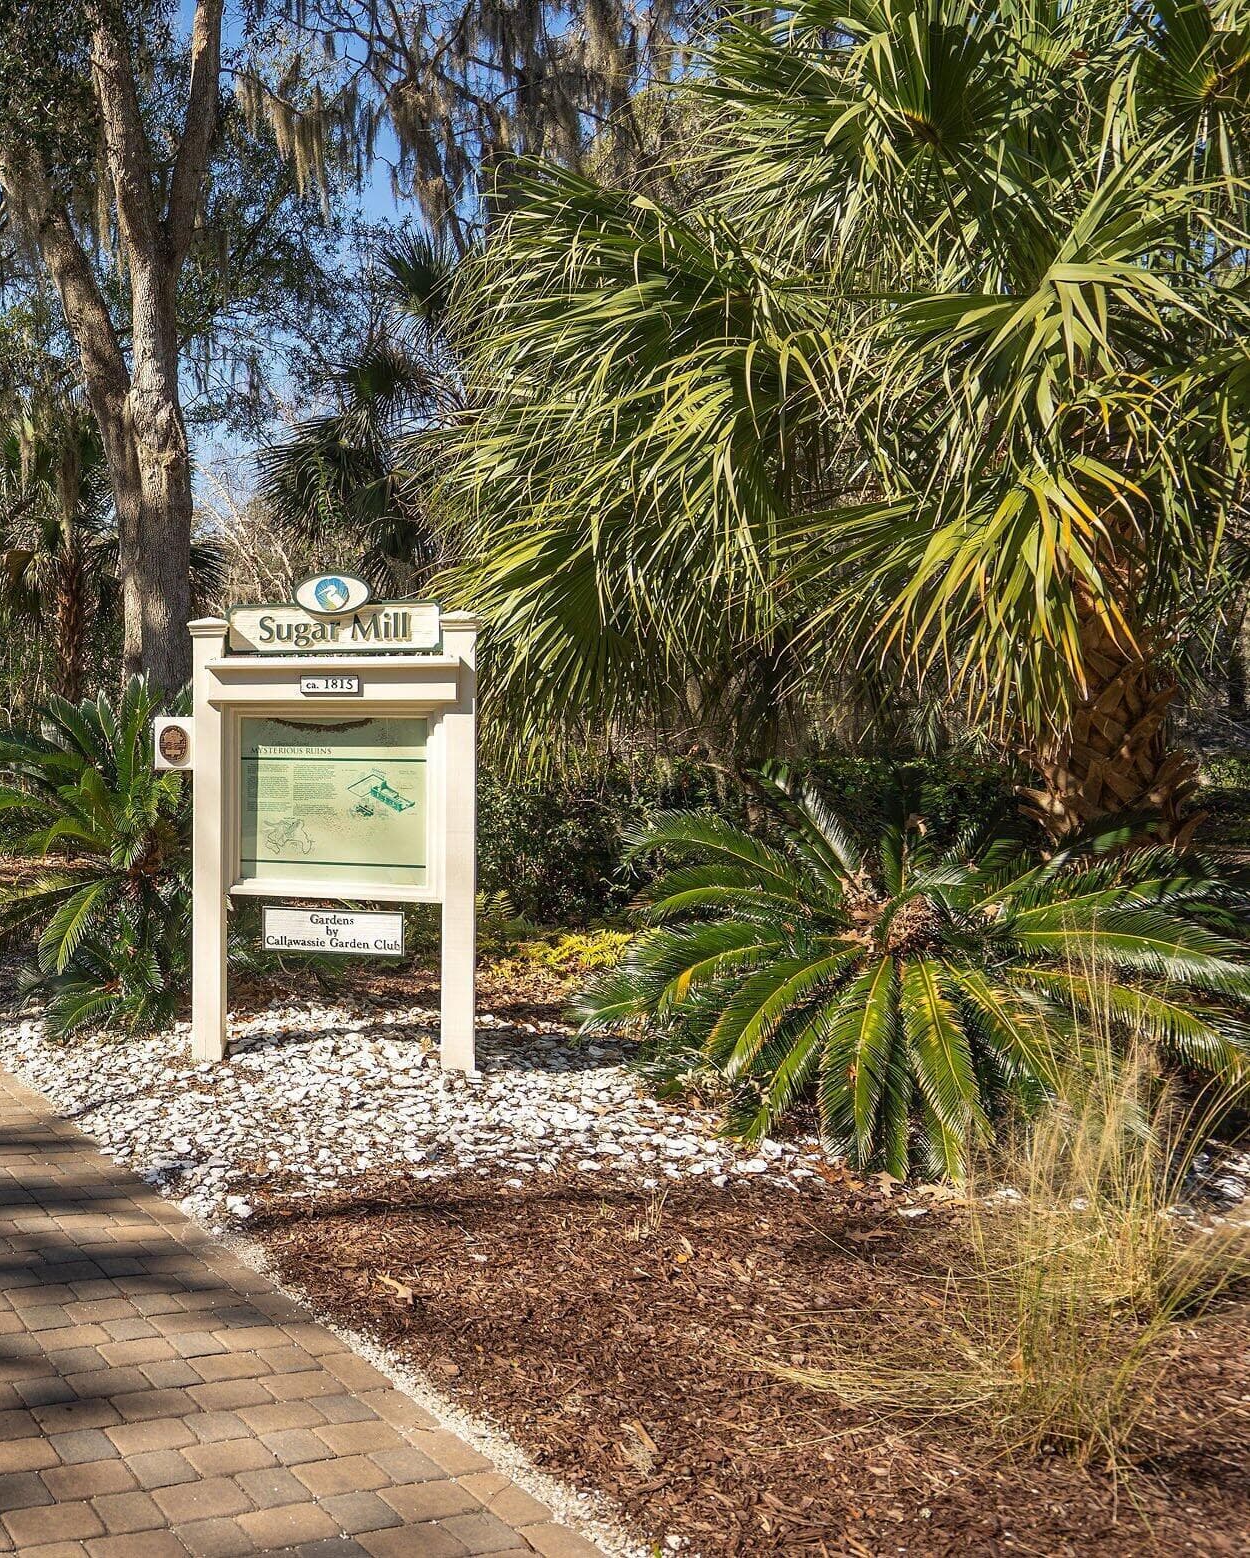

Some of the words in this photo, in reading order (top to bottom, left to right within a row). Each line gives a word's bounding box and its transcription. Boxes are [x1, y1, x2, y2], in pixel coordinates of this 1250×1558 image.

[258, 615, 341, 647] Sugar
[351, 611, 409, 640] Mill
[305, 681, 320, 690] ca.
[324, 679, 354, 690] 1815
[251, 746, 303, 754] MYSTERIOUS
[305, 747, 333, 755] RUINS
[309, 913, 355, 925] Gardens
[325, 925, 339, 938] by
[266, 935, 326, 947] Callawassie
[329, 937, 370, 950] Garden
[373, 939, 401, 951] Club
